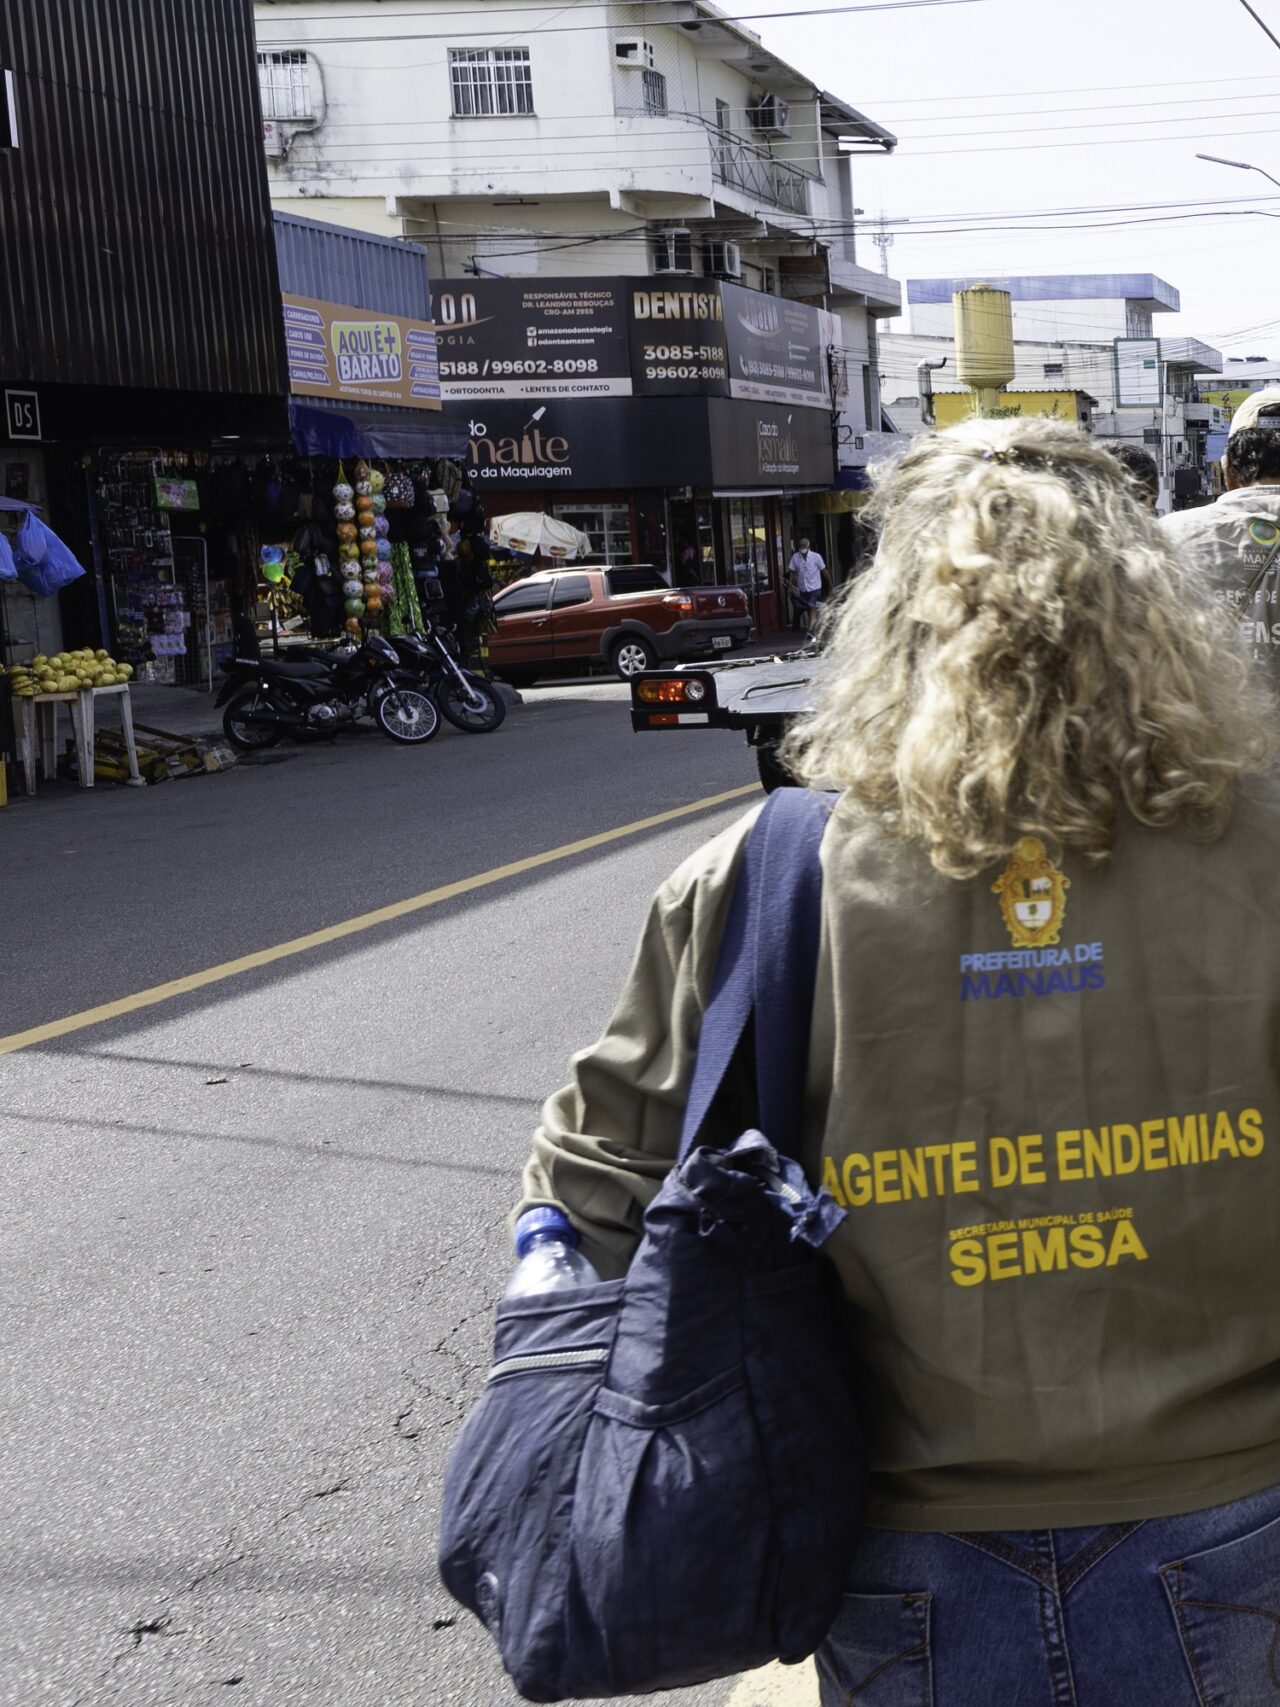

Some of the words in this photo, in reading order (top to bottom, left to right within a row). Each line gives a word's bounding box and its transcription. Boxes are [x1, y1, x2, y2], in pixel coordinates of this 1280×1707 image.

[523, 291, 578, 300] RESPONSÁVEL
[579, 290, 612, 299] TÉCNICO
[522, 300, 535, 309] DR.
[535, 299, 572, 309] LEANDRO
[573, 299, 614, 308] REBOUÇAS
[544, 308, 575, 316] CRO-AM
[576, 307, 594, 316] 2955
[633, 292, 724, 322] DENTISTA
[537, 326, 613, 336] amazonodontologia
[339, 330, 372, 356] AQUI
[537, 337, 595, 346] odontoamazon
[643, 345, 724, 362] 3085-5188
[340, 354, 399, 380] BARATO
[491, 358, 599, 375] 99602-8098
[645, 366, 726, 380] 99602-8098
[449, 386, 506, 395] ORTODONTIA
[525, 385, 553, 394] LENTES
[554, 385, 567, 393] DE
[567, 384, 611, 393] CONTATO
[14, 402, 33, 428] DS
[480, 466, 498, 478] da
[500, 465, 572, 479] Maquiagem
[960, 949, 1072, 973] PREFEITURA
[1074, 942, 1104, 962] DE
[960, 964, 1105, 1001] MANAUS
[820, 1141, 980, 1208] AGENTE
[989, 1134, 1047, 1188] DE
[1056, 1108, 1265, 1182] ENDEMIAS
[949, 1219, 1016, 1241] SECRETARIA
[1018, 1215, 1076, 1231] MUNICIPAL
[1078, 1211, 1095, 1224] DE
[1096, 1206, 1134, 1223] SAÚDE
[949, 1219, 1149, 1287] SEMSA
